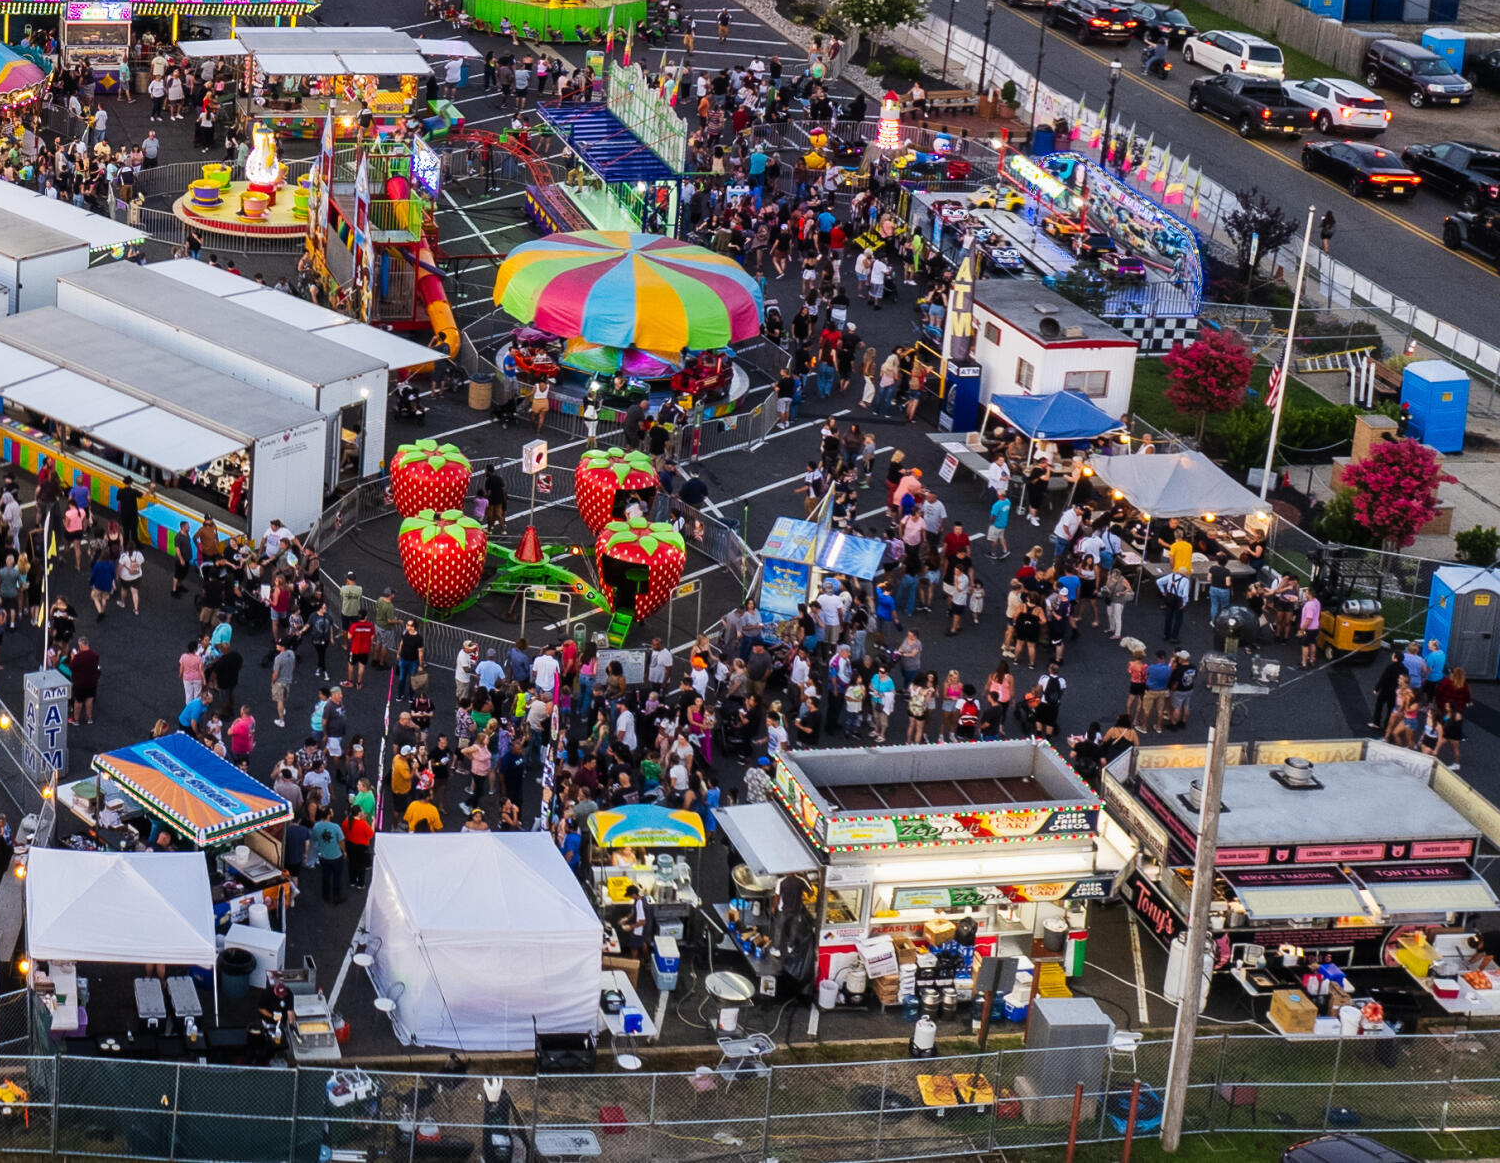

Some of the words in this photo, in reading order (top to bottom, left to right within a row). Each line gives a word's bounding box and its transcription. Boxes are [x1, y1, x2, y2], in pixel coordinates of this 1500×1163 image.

[950, 256, 974, 338] ATM
[959, 367, 980, 376] ATM
[43, 687, 67, 700] ATM
[43, 703, 63, 770] ATM
[987, 813, 1040, 825] FUNNEL
[1057, 812, 1086, 820] DEEP
[995, 819, 1033, 829] CAKE
[1054, 817, 1087, 826] FRIED
[1049, 822, 1090, 832] OREOS
[1374, 869, 1421, 877] TONY'S
[1028, 888, 1061, 897] CAKE
[1135, 879, 1175, 935] Tony's
[871, 923, 907, 934] PLEASE
